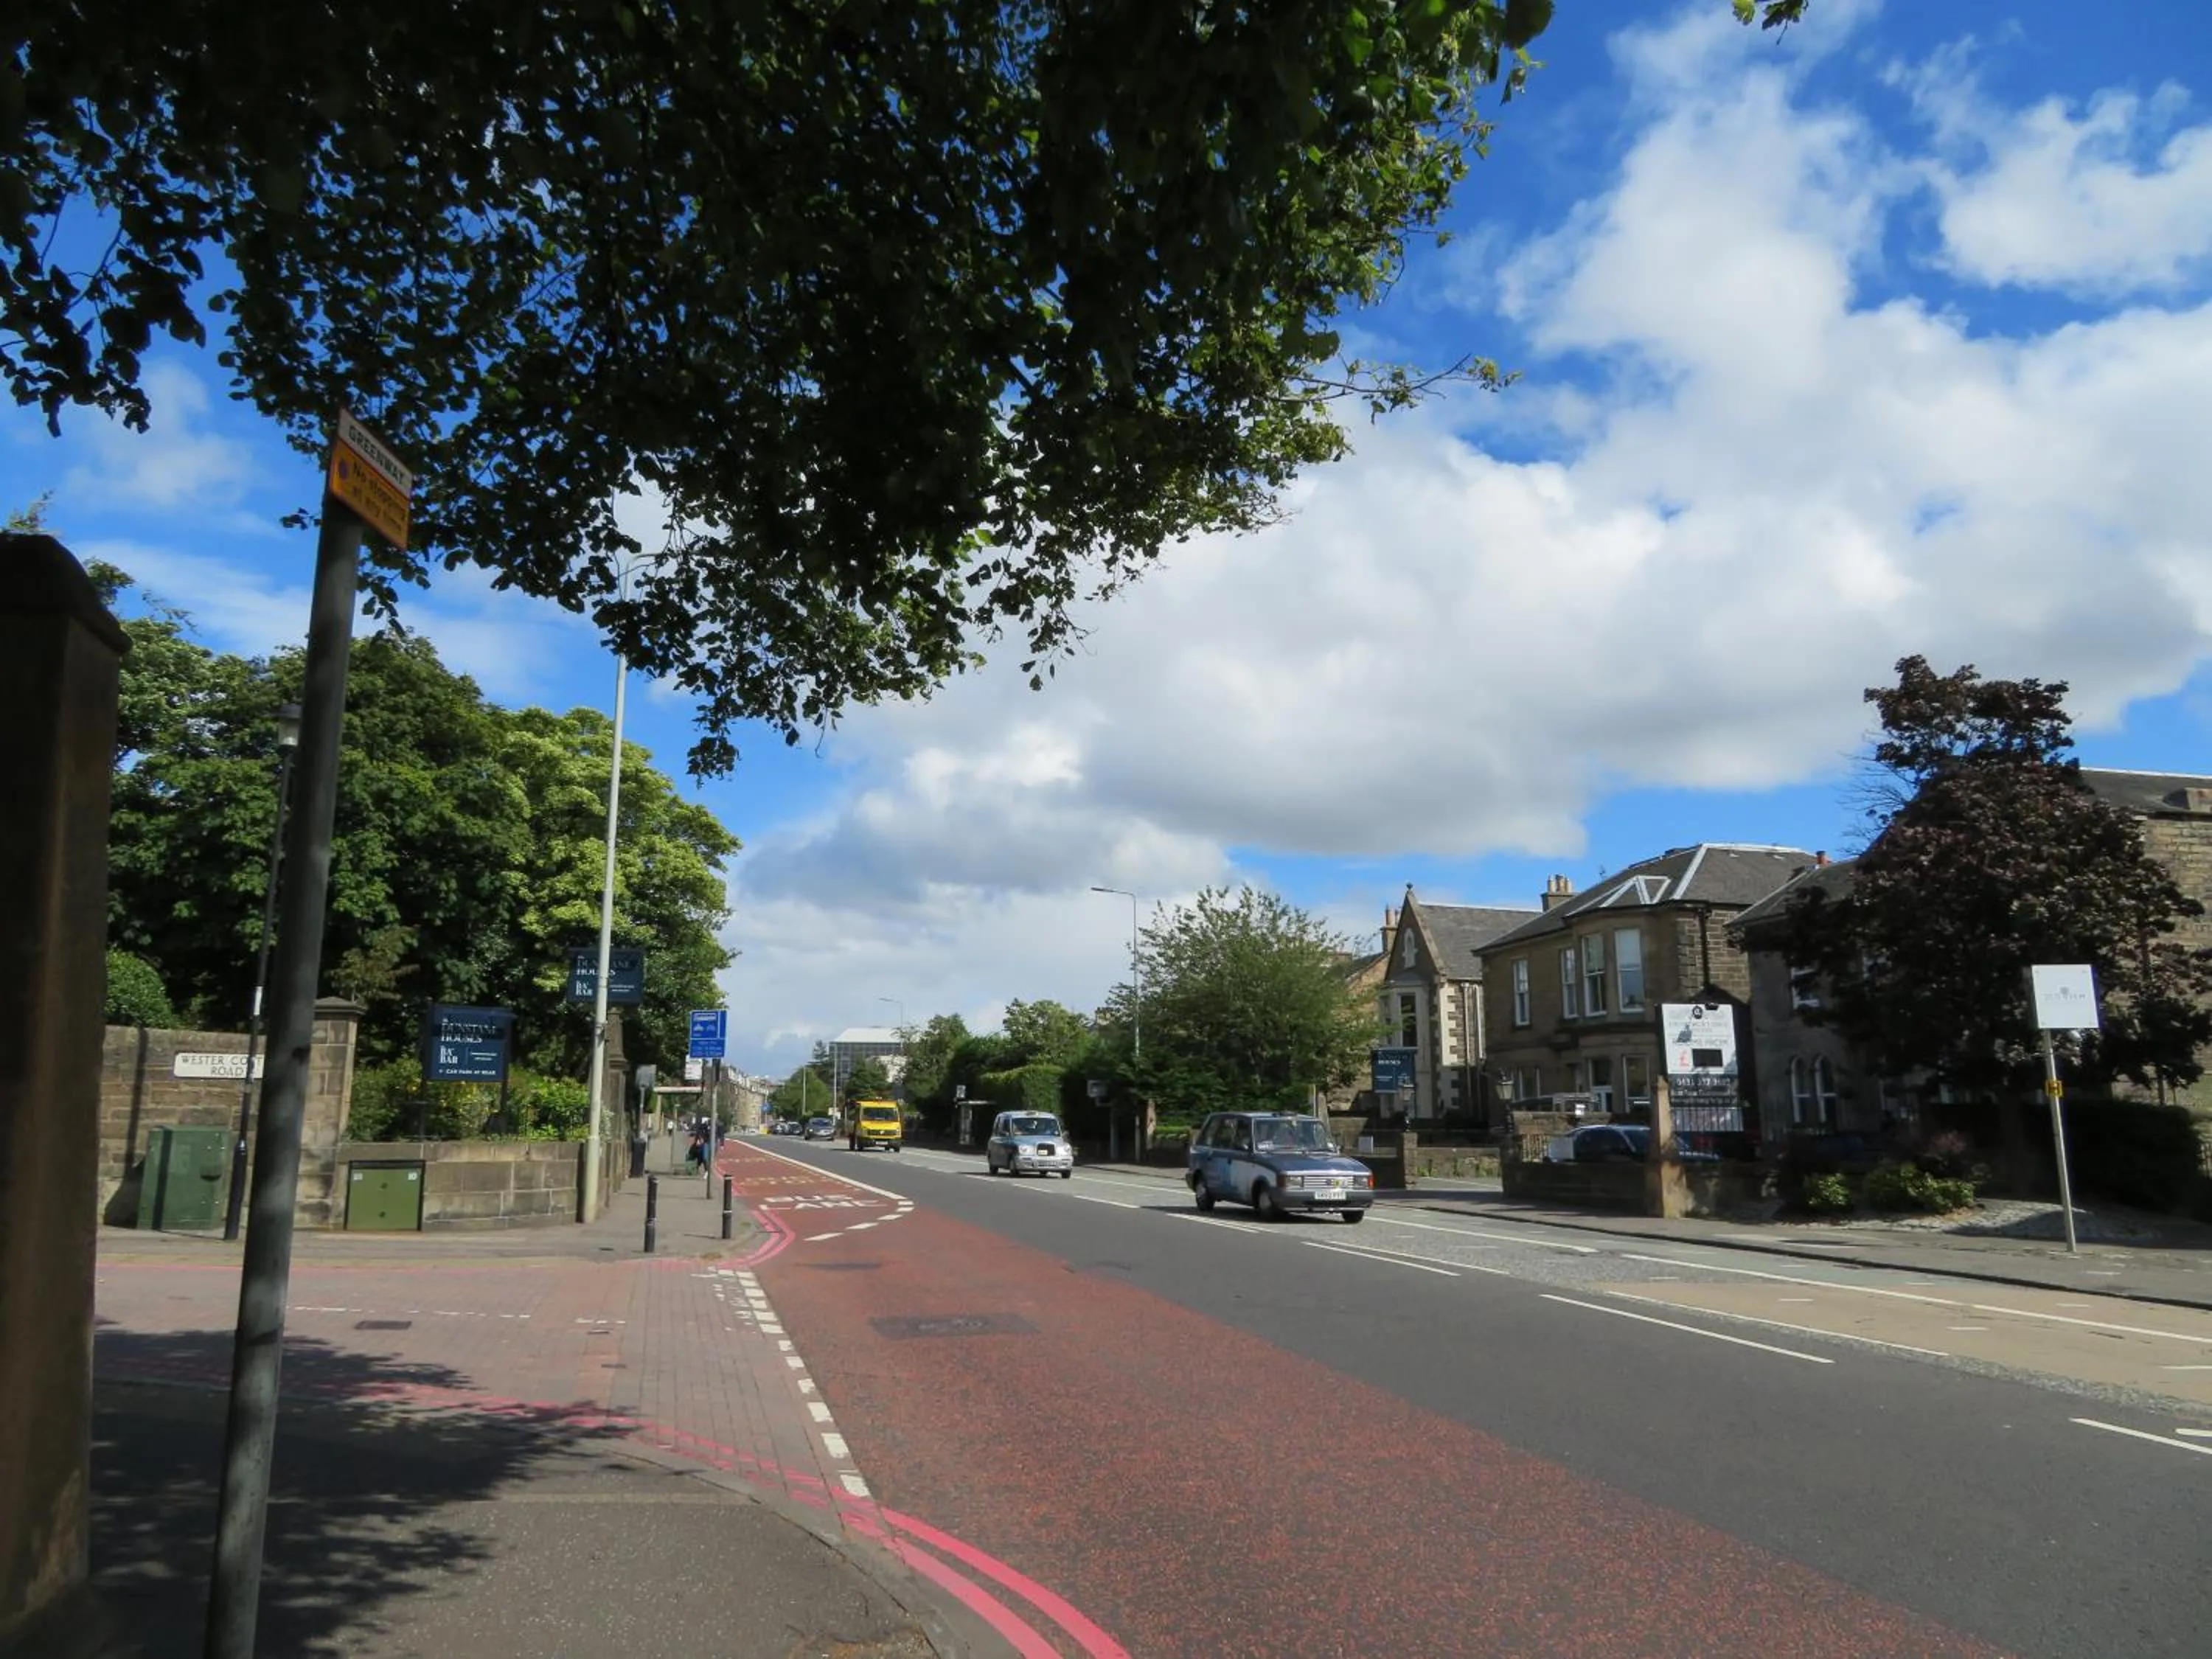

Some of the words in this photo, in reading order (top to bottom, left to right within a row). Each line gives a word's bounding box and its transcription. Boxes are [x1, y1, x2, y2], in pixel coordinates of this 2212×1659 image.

[349, 425, 405, 484] GREENWAY
[181, 1055, 224, 1065] WESTER
[212, 1066, 244, 1076] ROAD
[759, 1200, 887, 1211] LANE
